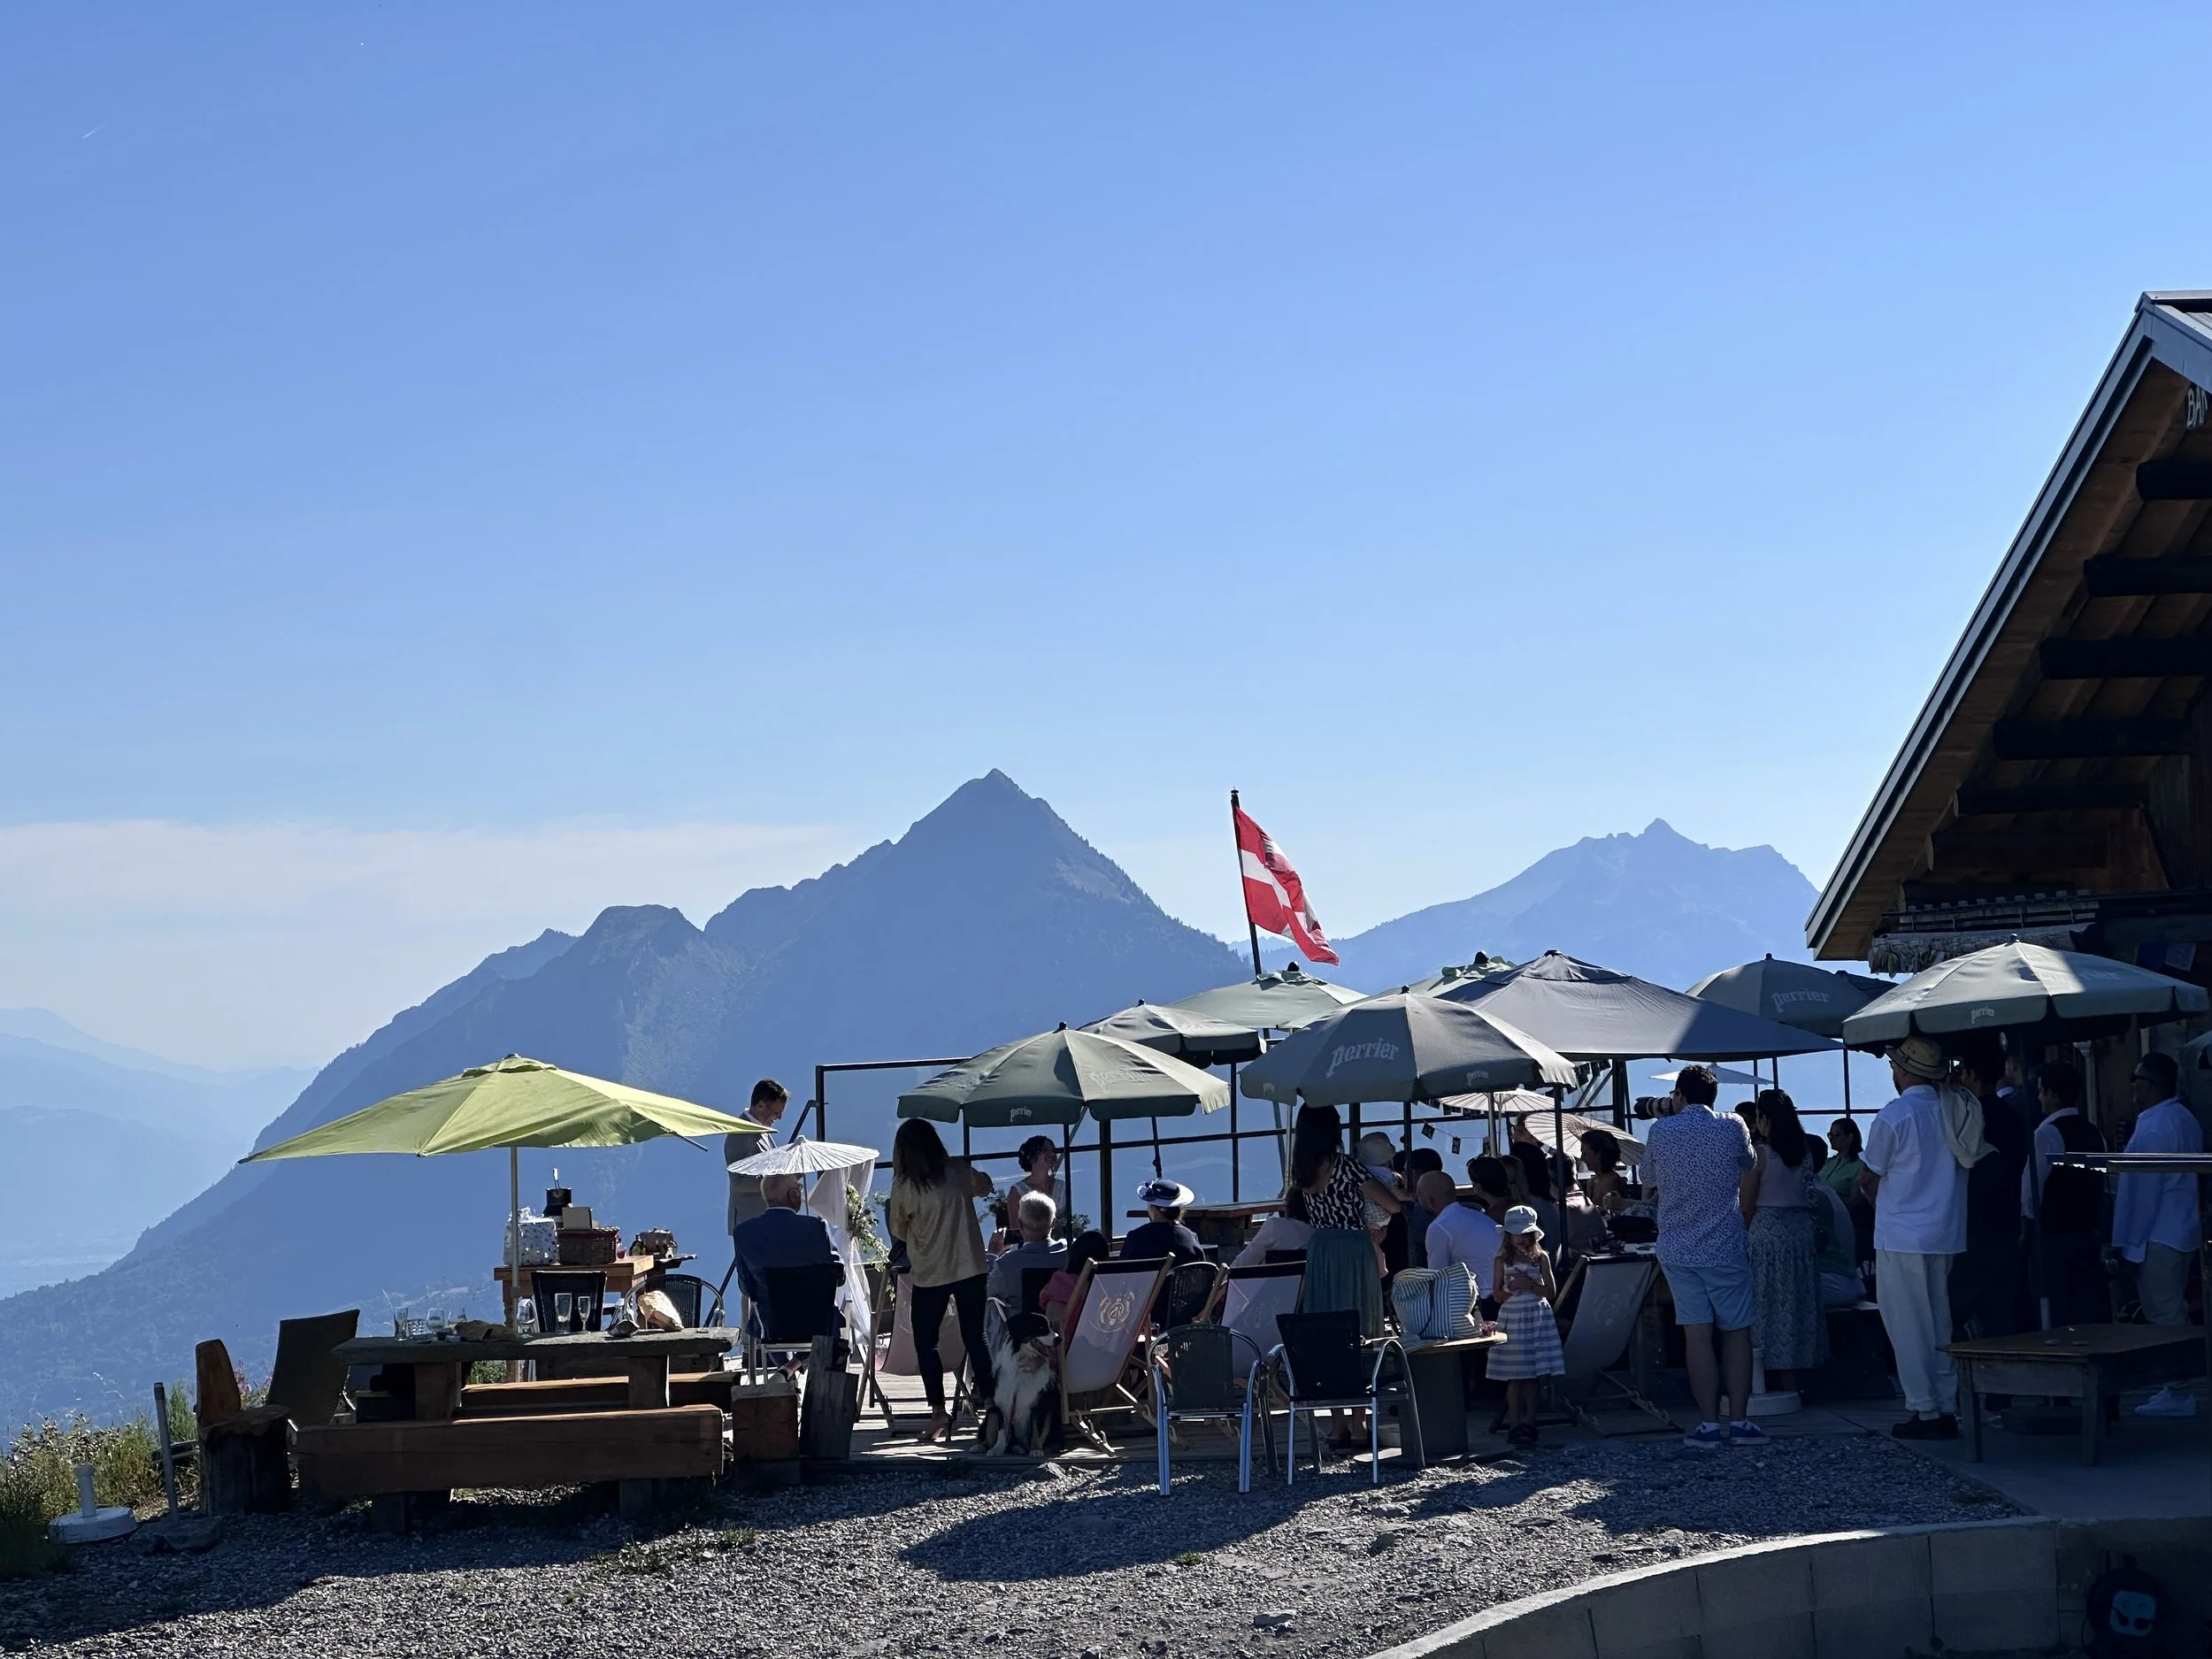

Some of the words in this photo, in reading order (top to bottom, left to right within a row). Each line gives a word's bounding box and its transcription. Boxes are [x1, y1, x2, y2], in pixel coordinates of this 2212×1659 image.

[1771, 988, 1830, 1013] perrier
[1326, 1038, 1399, 1079] perrier
[1010, 1106, 1033, 1122] perrier
